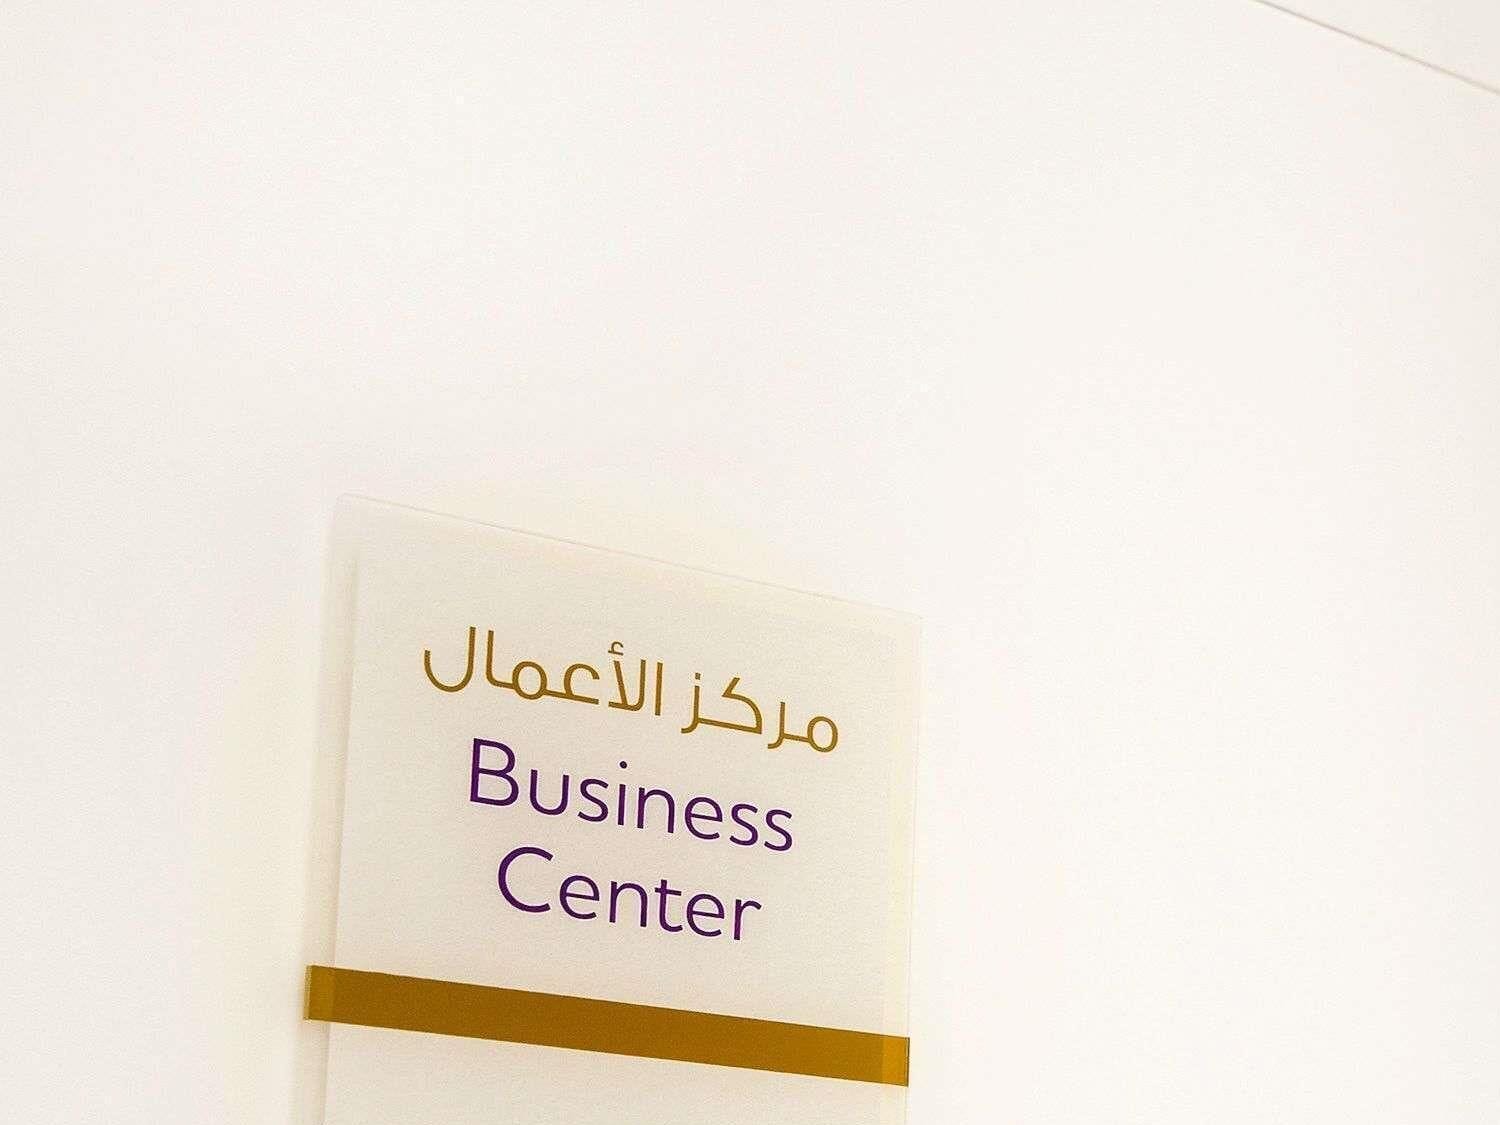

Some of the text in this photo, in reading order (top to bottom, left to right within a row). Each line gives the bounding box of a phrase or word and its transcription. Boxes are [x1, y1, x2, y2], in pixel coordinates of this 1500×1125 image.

[423, 625, 840, 754] مركز الأعمال
[468, 736, 796, 854] Business
[496, 844, 764, 943] Center
